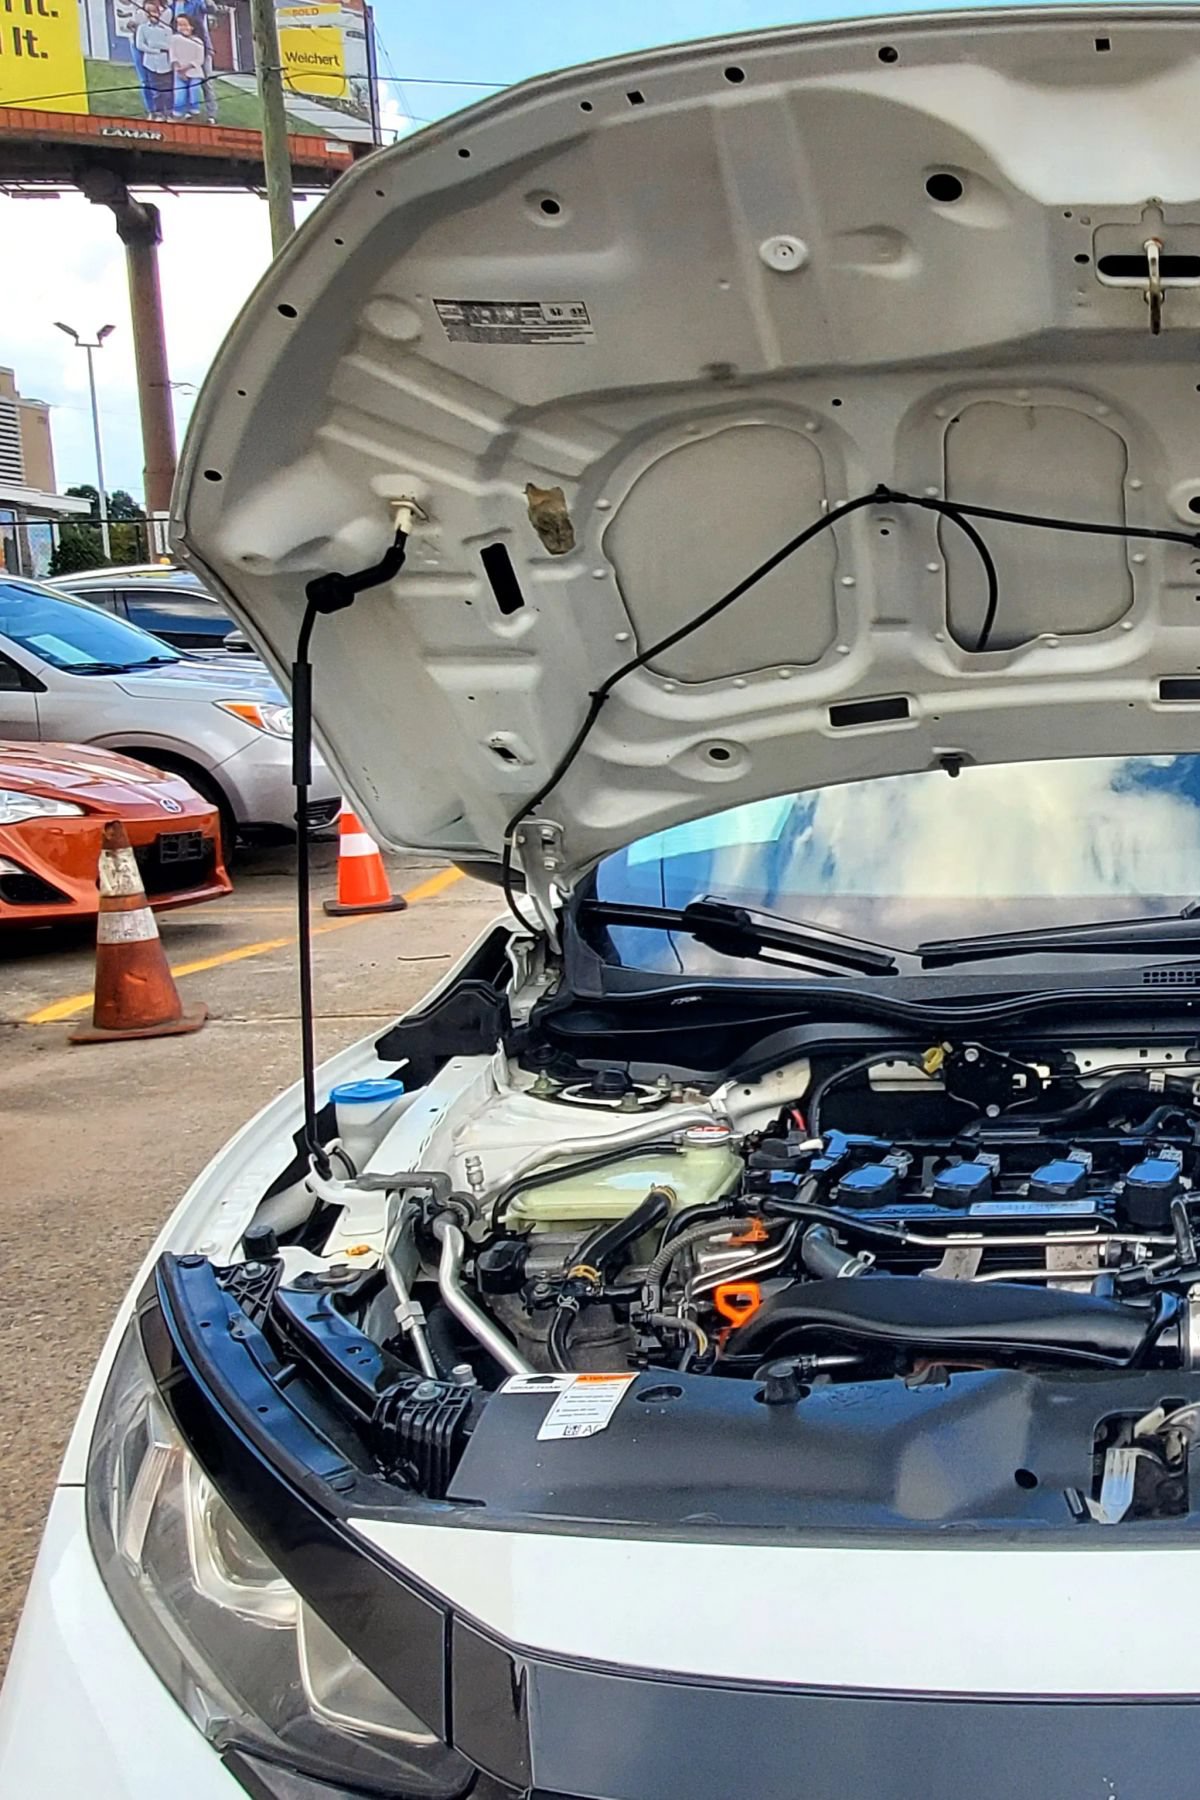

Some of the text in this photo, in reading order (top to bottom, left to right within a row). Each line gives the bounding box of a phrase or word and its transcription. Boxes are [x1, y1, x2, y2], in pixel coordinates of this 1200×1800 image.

[12, 26, 49, 59] It.
[285, 50, 341, 67] Weichert
[102, 128, 161, 140] LAMAR
